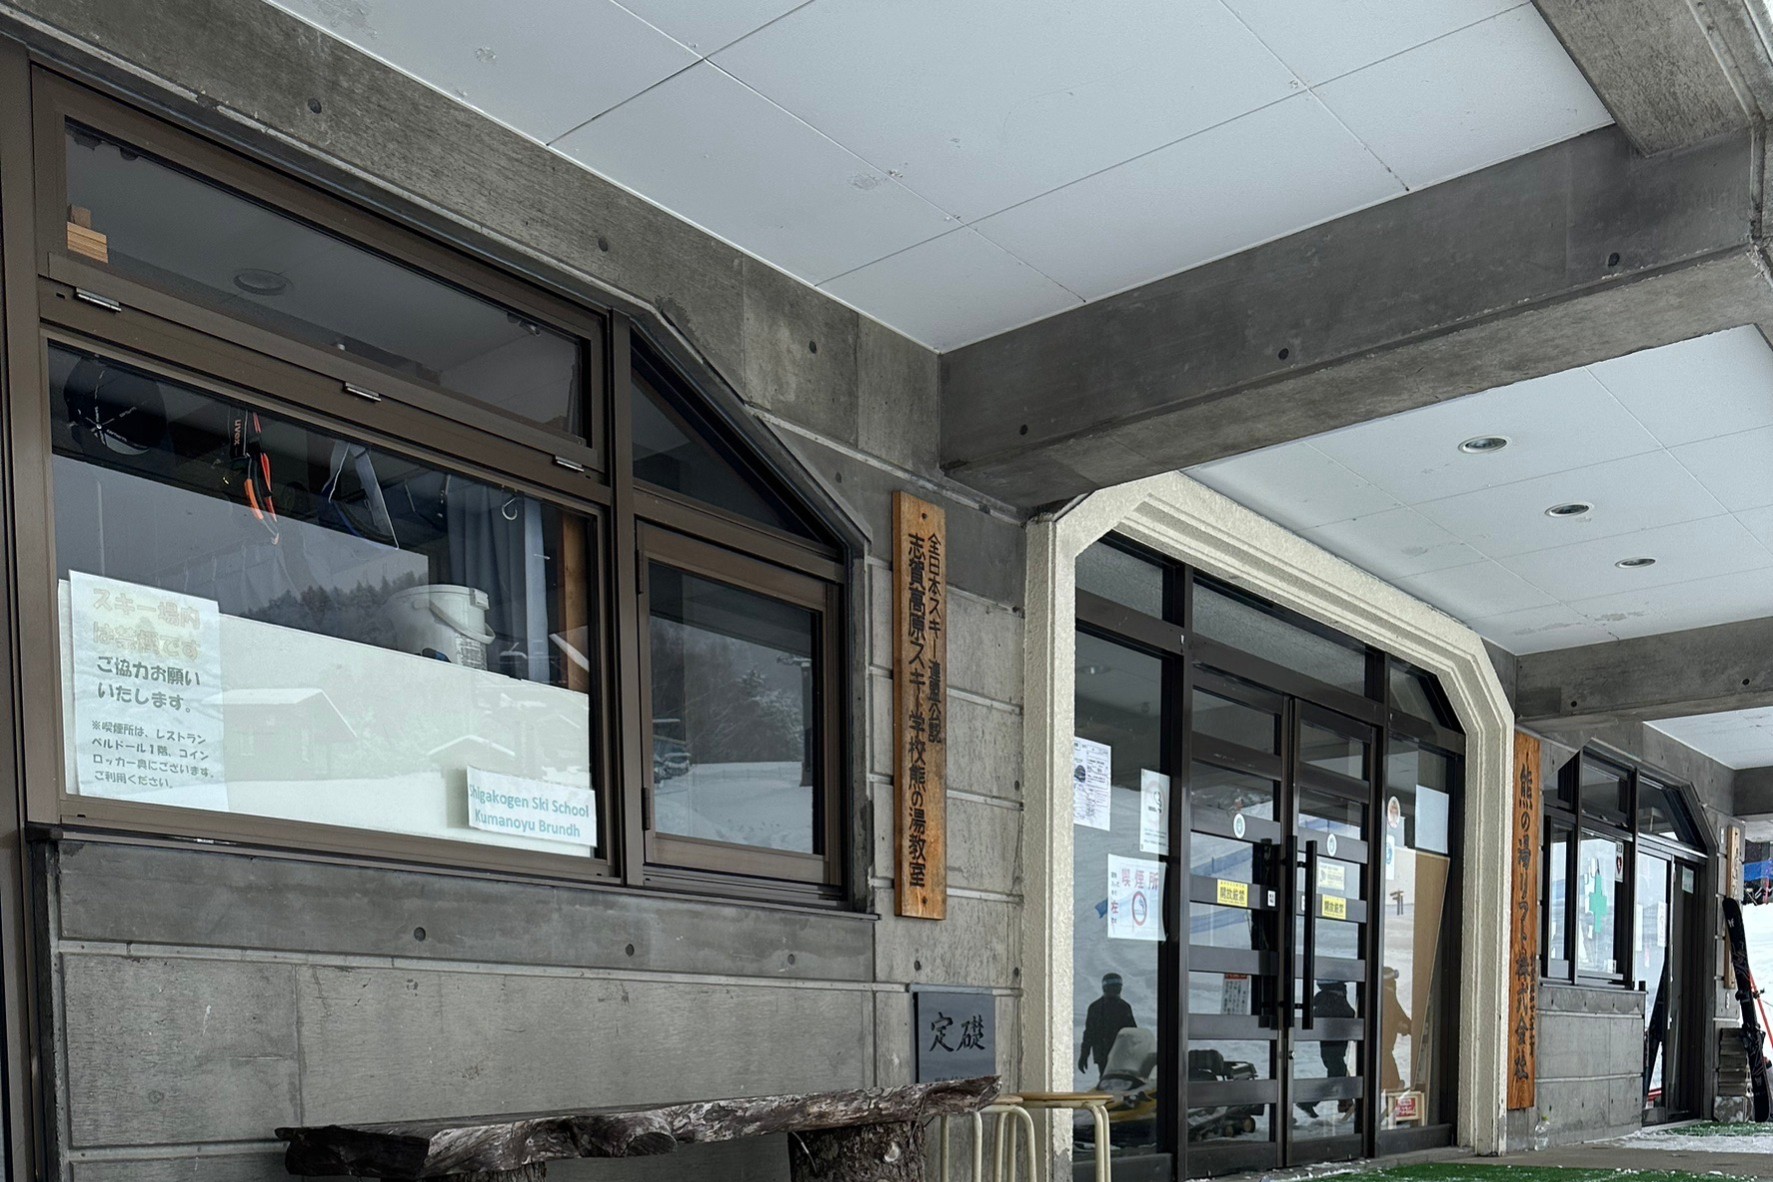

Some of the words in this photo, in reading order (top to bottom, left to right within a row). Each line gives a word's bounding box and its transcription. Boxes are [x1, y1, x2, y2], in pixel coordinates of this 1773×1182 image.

[93, 588, 201, 630] スキー場内
[93, 620, 201, 662] は禁煙です
[928, 532, 942, 744] 全日本スキー連盟公認
[97, 655, 201, 686] ご協力お願い
[97, 682, 191, 713] いたします。
[94, 770, 173, 789] ご利用ください。
[469, 783, 529, 810] Shigakogen
[532, 797, 549, 812] Ski
[552, 800, 590, 818] School
[474, 808, 536, 833] Kumanoyu
[540, 820, 580, 838] Brundh
[929, 1011, 986, 1053] 定礎
